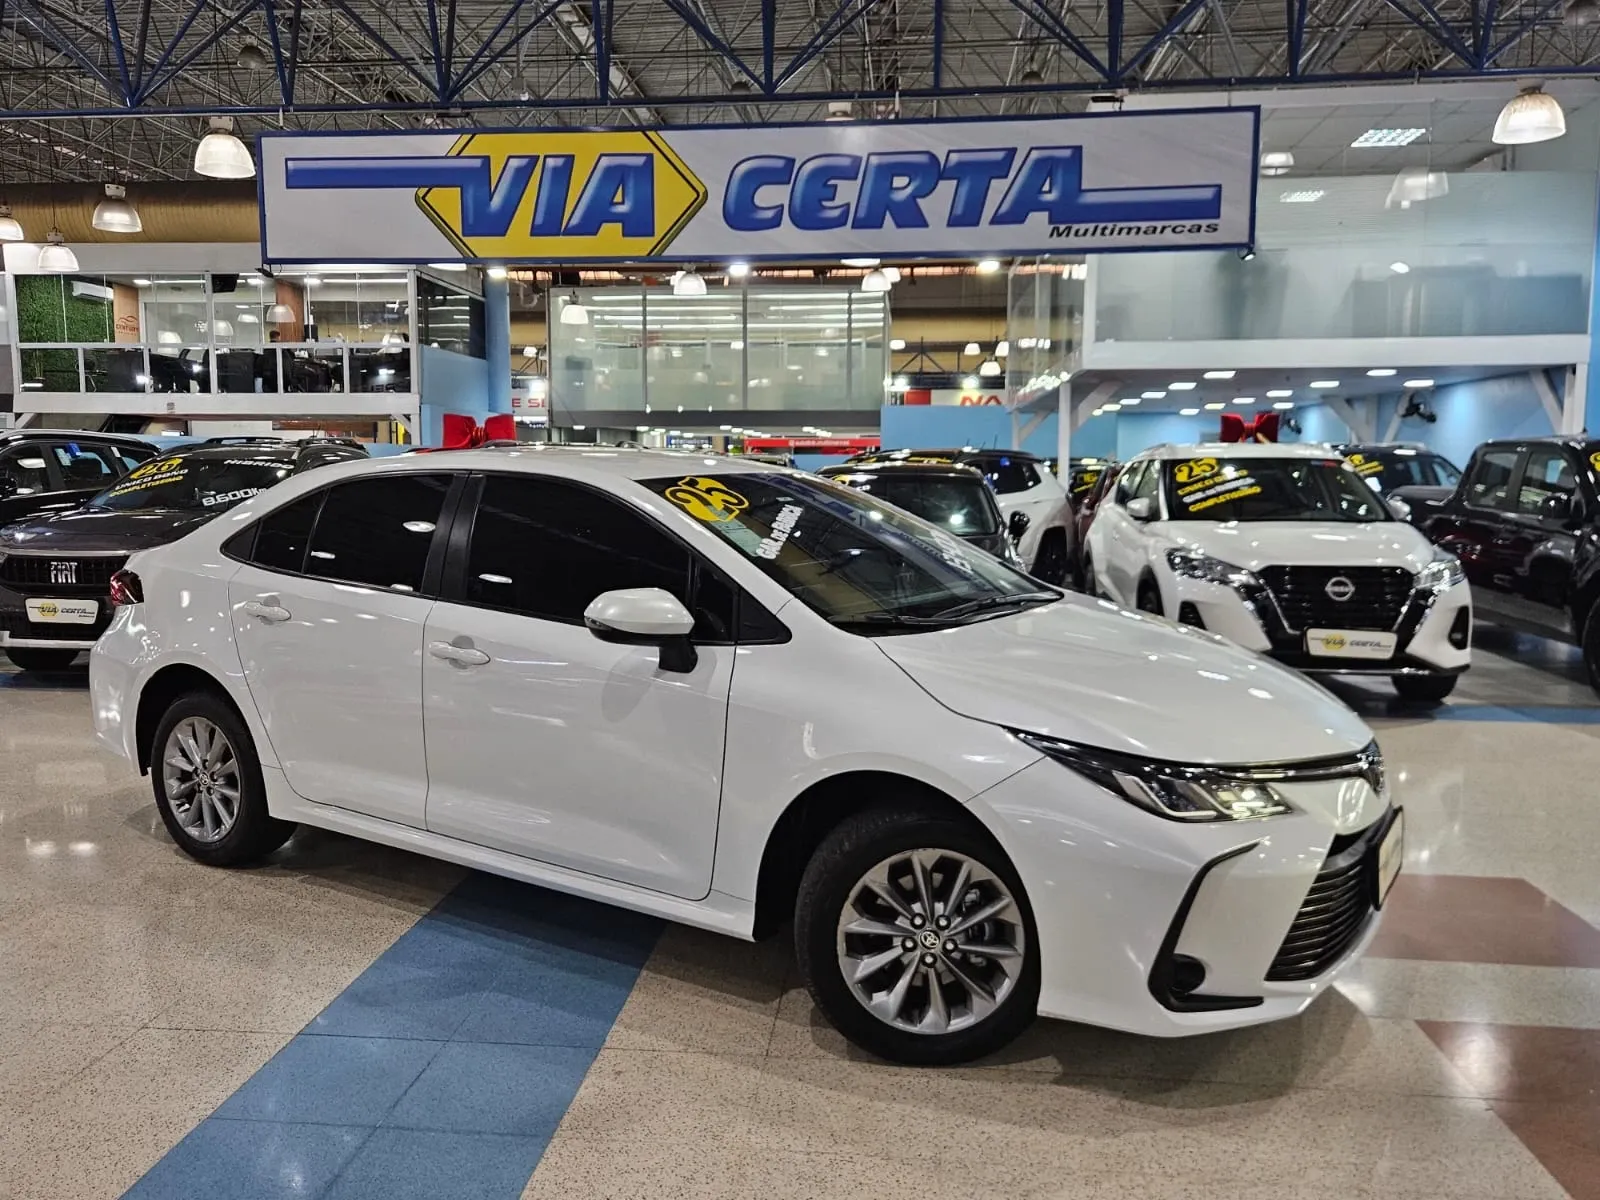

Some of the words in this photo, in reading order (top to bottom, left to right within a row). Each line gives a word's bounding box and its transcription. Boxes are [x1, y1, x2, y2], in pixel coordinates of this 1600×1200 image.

[460, 153, 656, 238] VIA
[722, 144, 1084, 232] CERTA
[1049, 222, 1219, 240] Multimarcas
[130, 457, 184, 479] 26
[1175, 457, 1218, 482] 25
[665, 476, 750, 522] 25
[50, 561, 78, 584] FIAT
